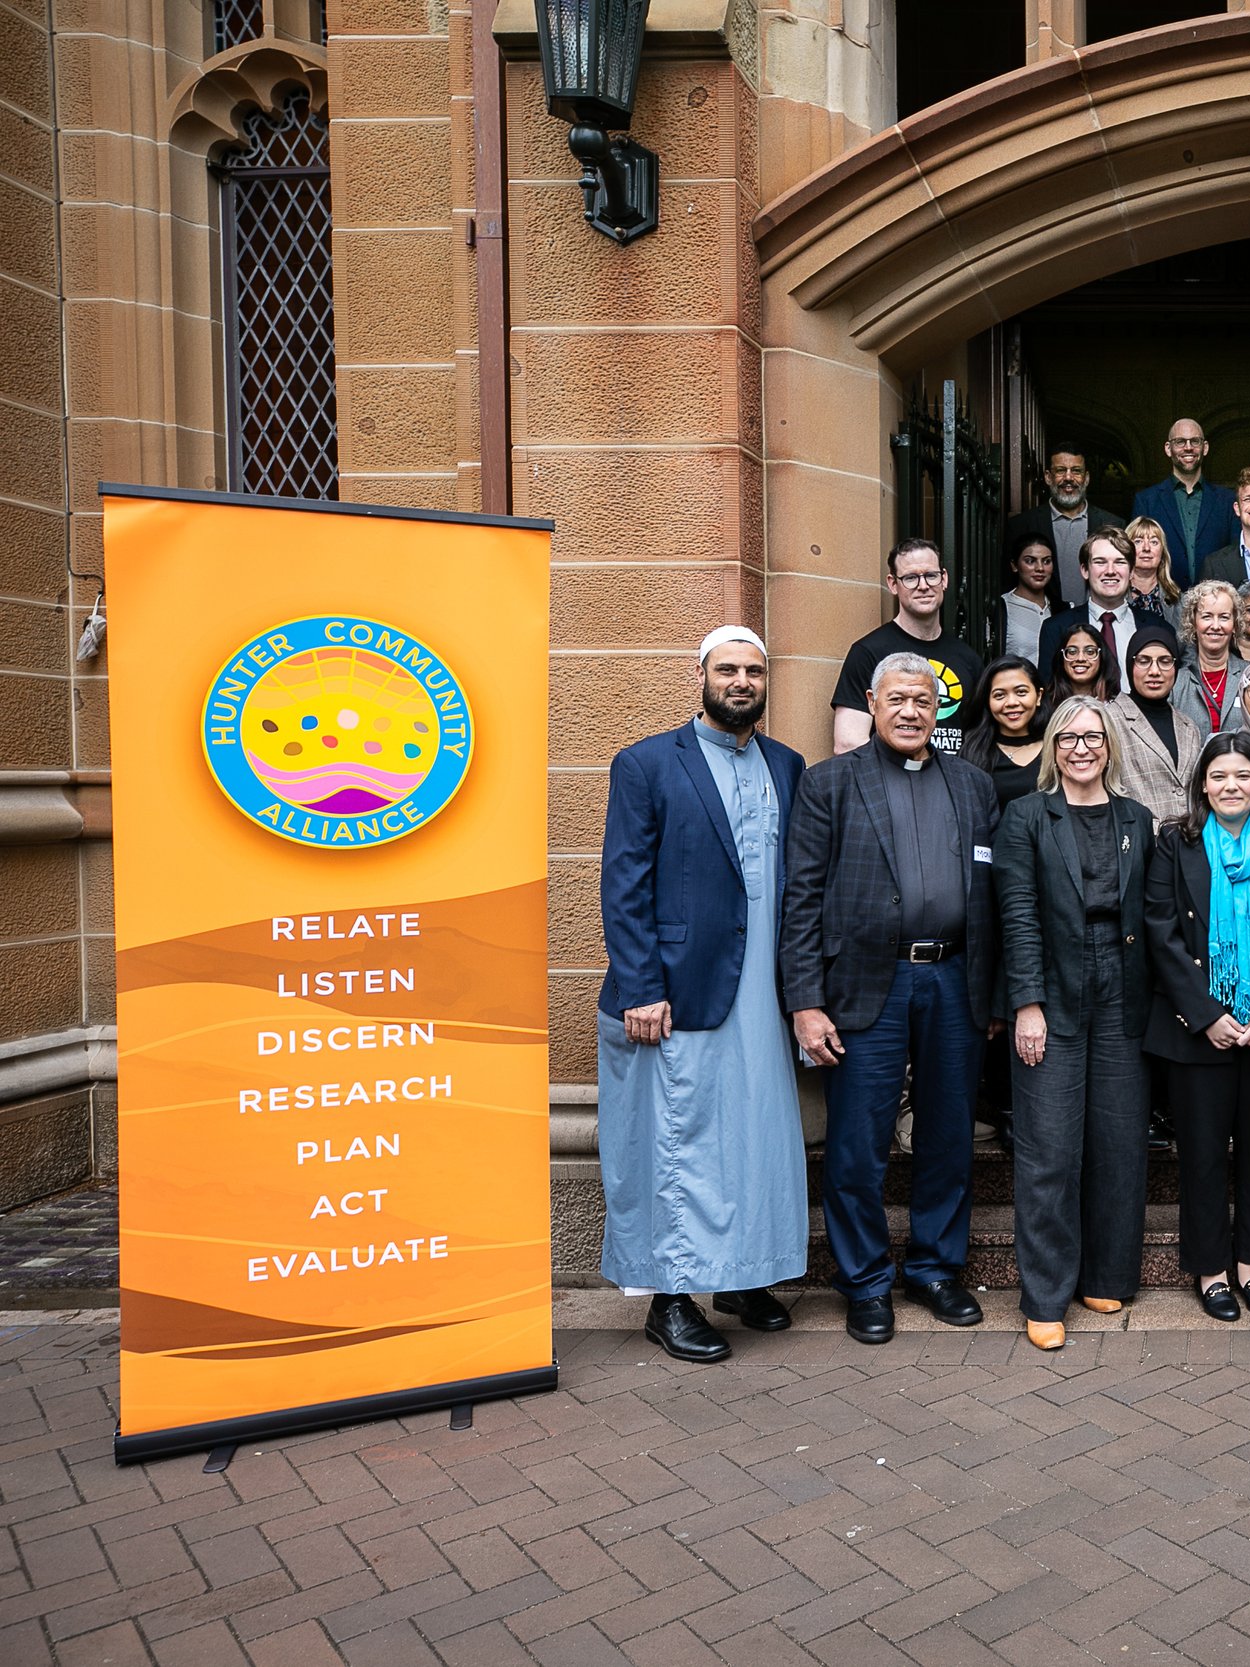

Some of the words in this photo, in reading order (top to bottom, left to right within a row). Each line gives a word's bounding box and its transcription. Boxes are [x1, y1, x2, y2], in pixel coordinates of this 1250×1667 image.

[212, 632, 295, 746] HUNTER
[323, 620, 468, 760] COMMUNITY
[930, 736, 962, 750] MATE
[948, 728, 962, 737] FOR
[256, 800, 426, 844] ALLIANCE
[271, 912, 421, 942] RELATE
[277, 967, 416, 999] LISTEN
[257, 1021, 434, 1056] DISCERN
[239, 1074, 453, 1114] RESEARCH
[296, 1133, 401, 1165] PLAN
[309, 1188, 388, 1220] ACT
[247, 1235, 450, 1282] EVALUATE
